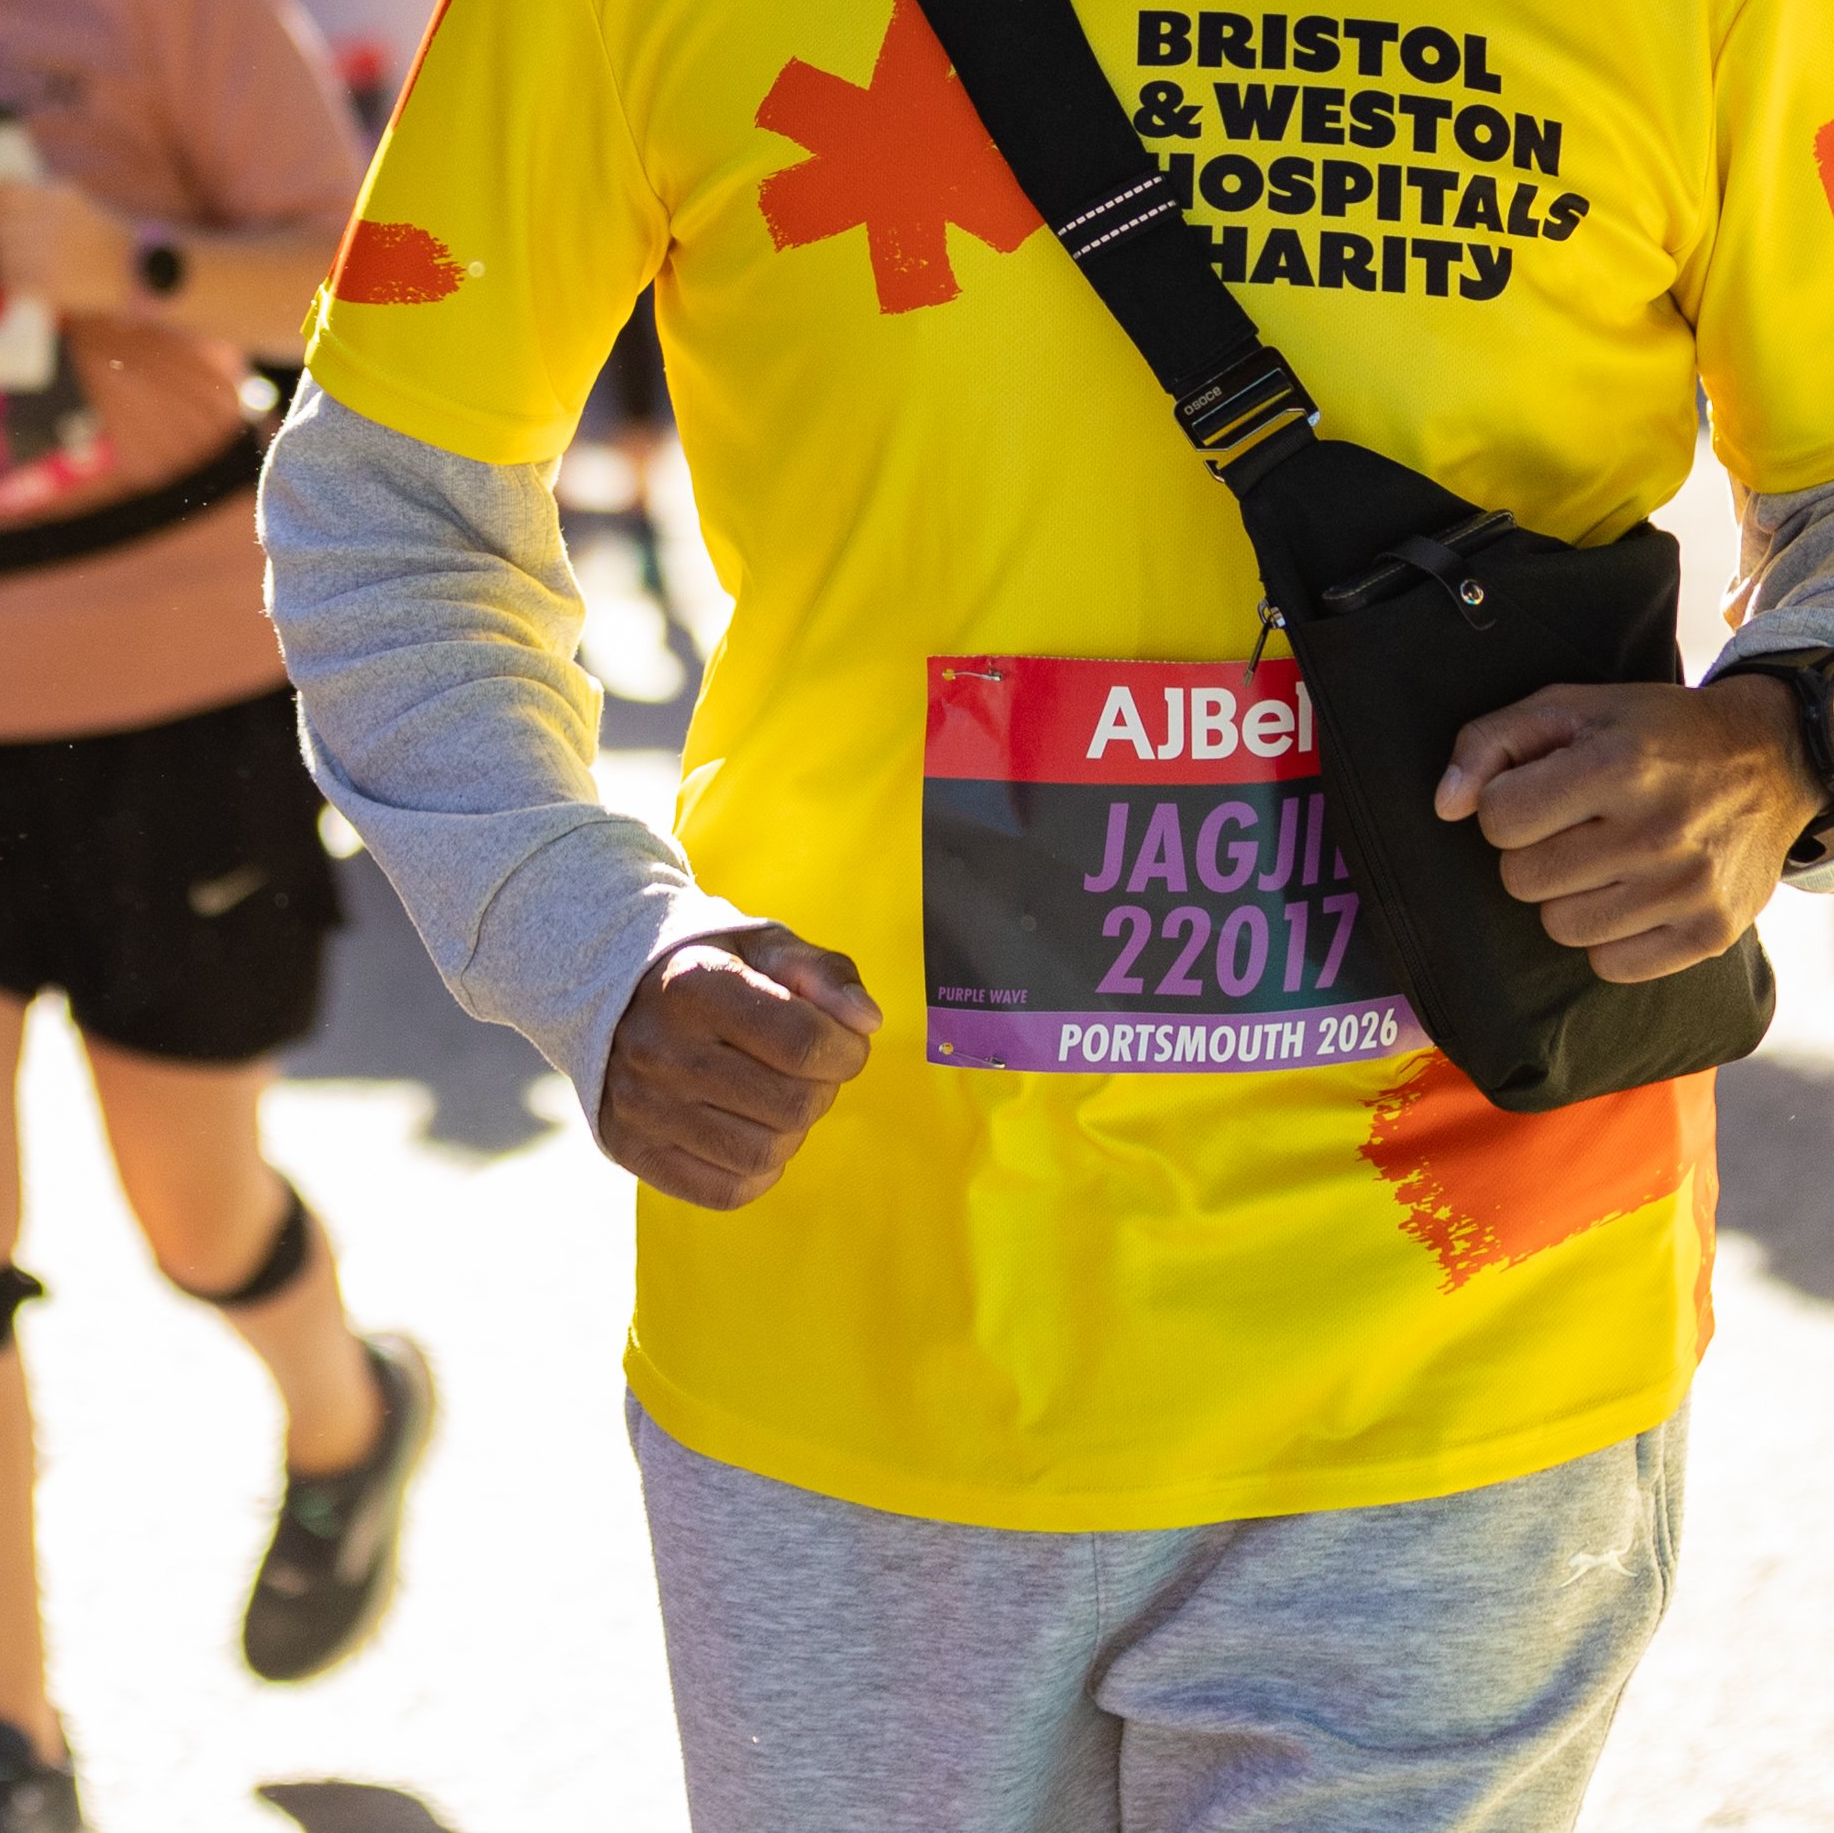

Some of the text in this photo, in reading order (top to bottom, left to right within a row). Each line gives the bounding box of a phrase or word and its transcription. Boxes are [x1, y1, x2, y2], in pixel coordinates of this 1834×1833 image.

[1137, 10, 1502, 94] BRISTOL
[1133, 81, 1562, 177] & WESTON
[1187, 225, 1513, 301] HARITY
[1086, 681, 1314, 759] AJBel
[1083, 792, 1350, 893] JAGJI
[1095, 892, 1361, 996] 22017
[938, 986, 1028, 1004] PURPLE WAVE
[1058, 1008, 1399, 1062] PORTSMOUTH 2026
